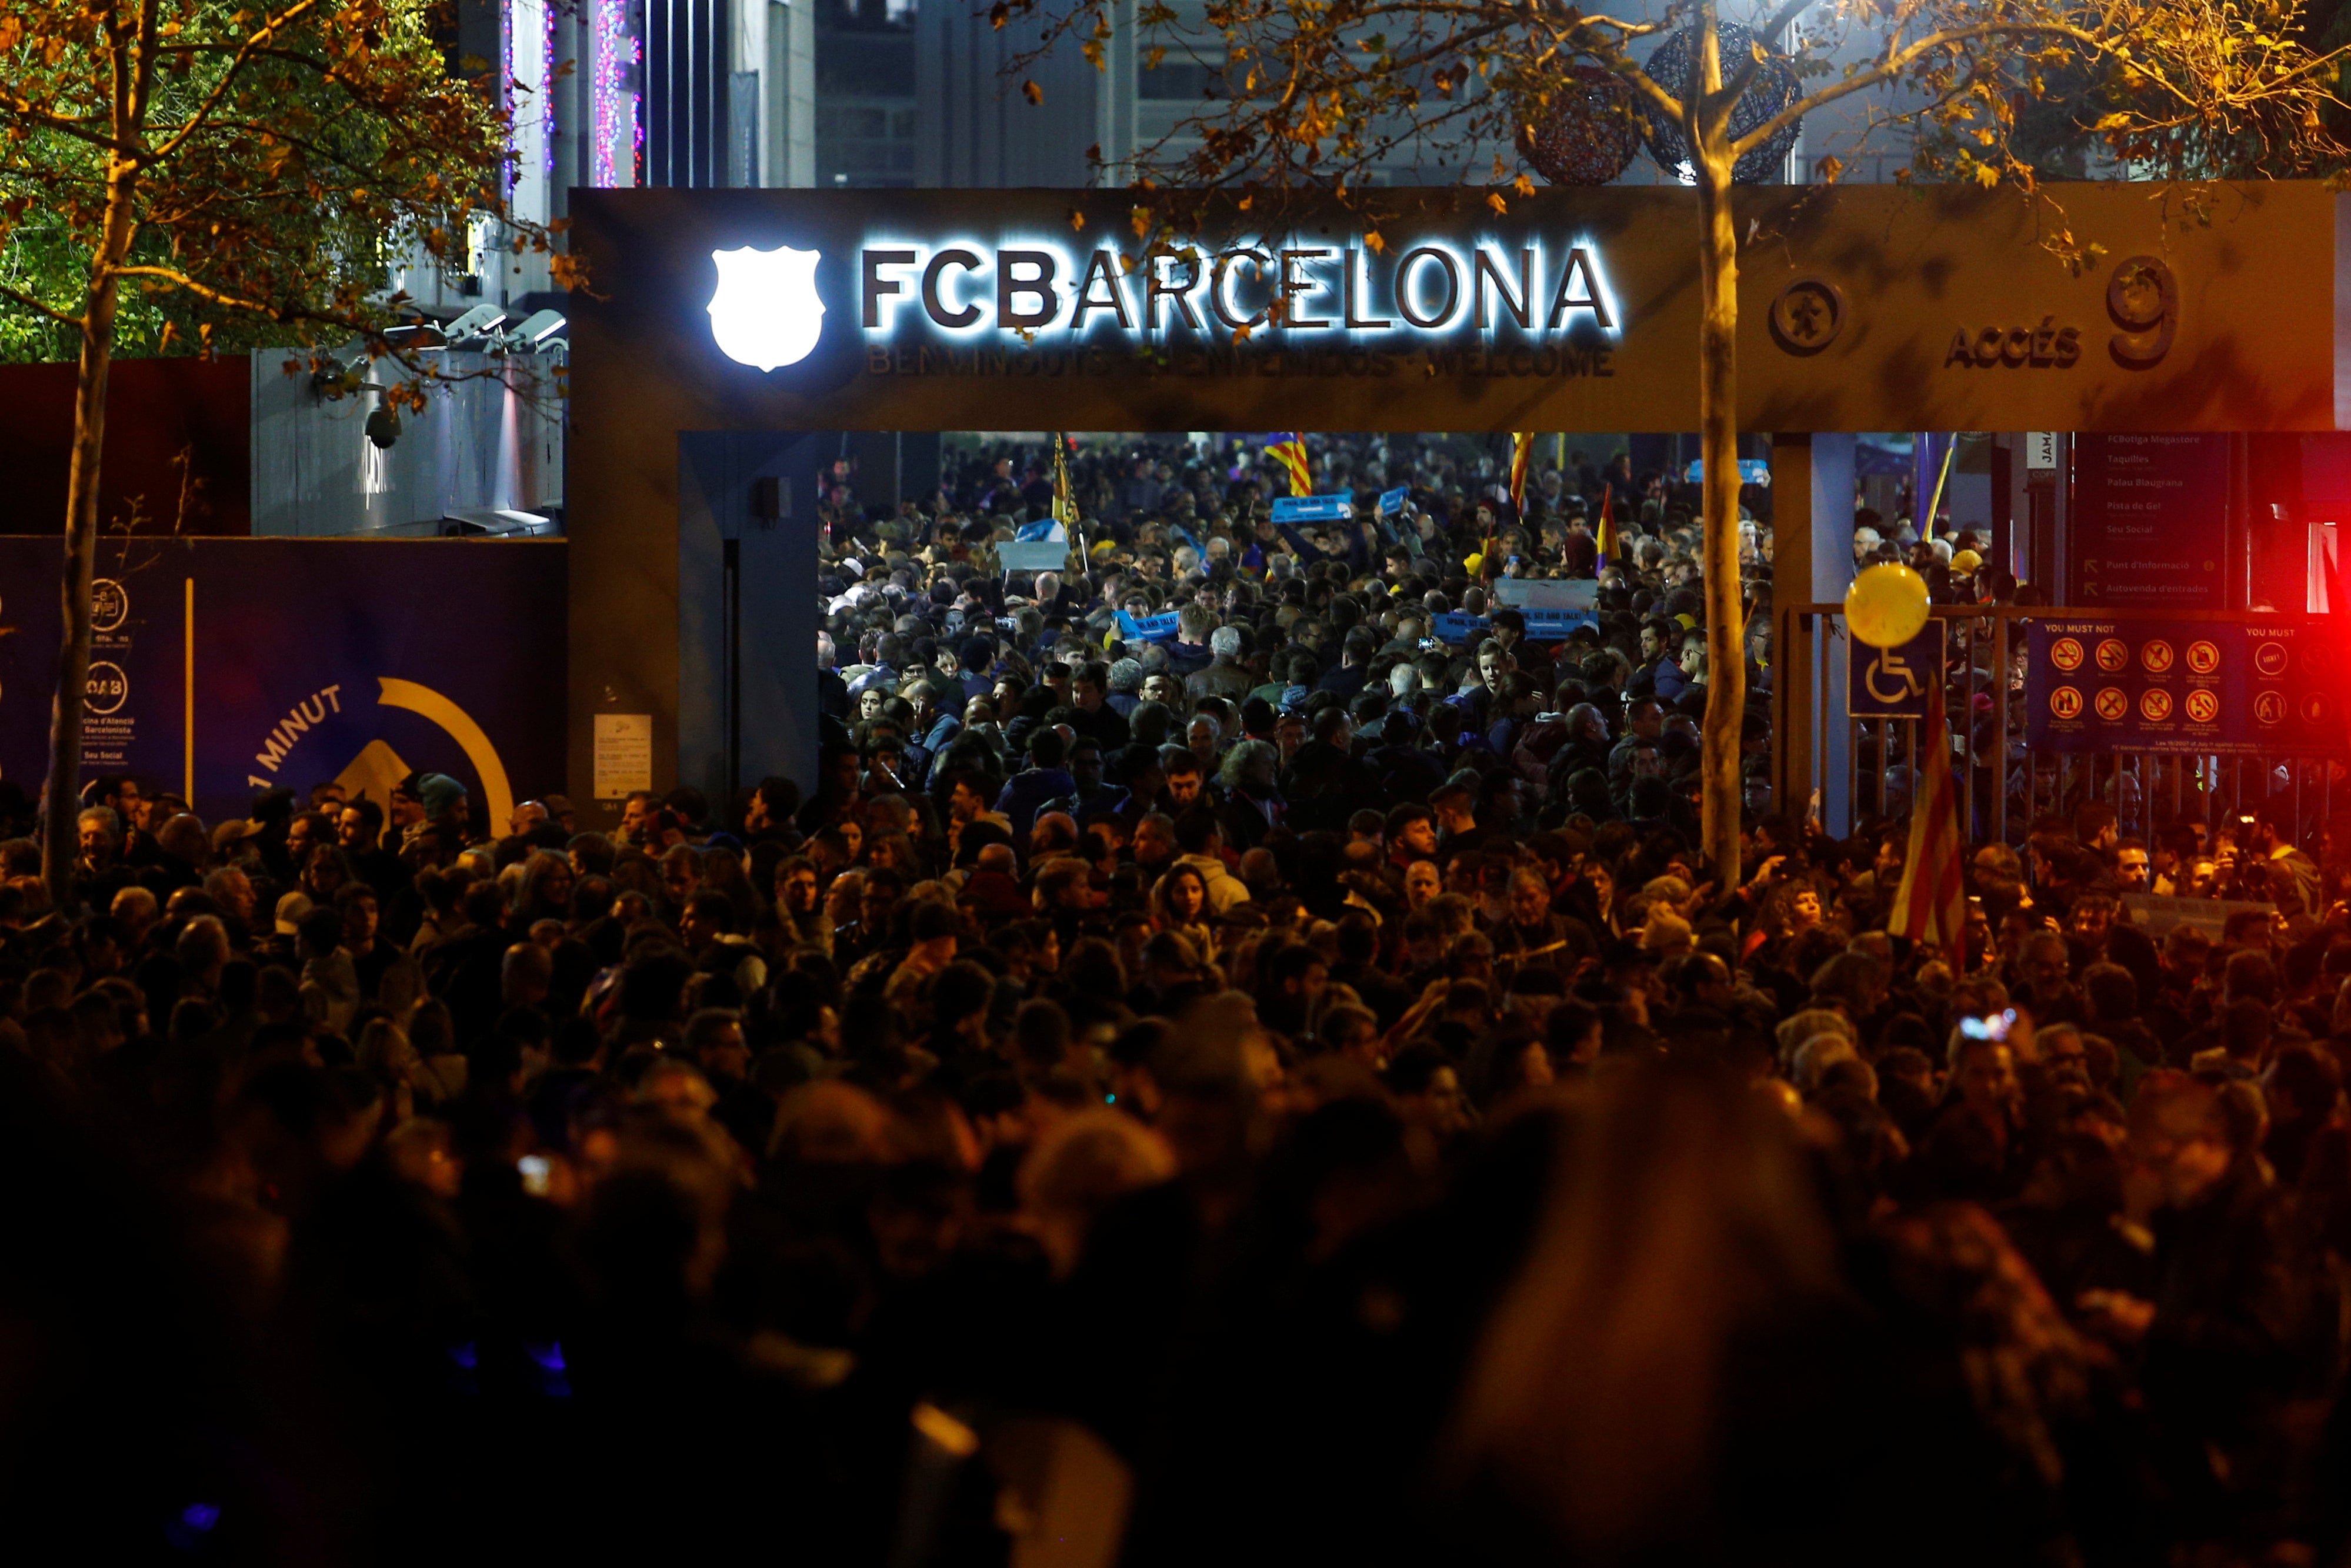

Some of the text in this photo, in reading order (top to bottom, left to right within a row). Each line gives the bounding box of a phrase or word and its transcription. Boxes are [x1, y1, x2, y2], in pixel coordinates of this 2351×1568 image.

[2106, 255, 2179, 371] 9
[1429, 345, 1615, 376] WELCOME
[2107, 435, 2200, 445] FCBotiga Megastore
[2107, 455, 2149, 465] Taquilles
[2107, 478, 2183, 489] Palau Blaugrana
[2106, 502, 2130, 510] Pista
[2106, 525, 2153, 533] Seu Social
[2106, 561, 2190, 569] Punt d'Informació
[2106, 584, 2209, 593] Autovenda d'entrades
[2045, 623, 2116, 633] YOU MUST NOT
[2246, 628, 2296, 637] YOU MUST
[247, 683, 342, 789] 1 MINUT
[84, 751, 122, 759] Seu Social
